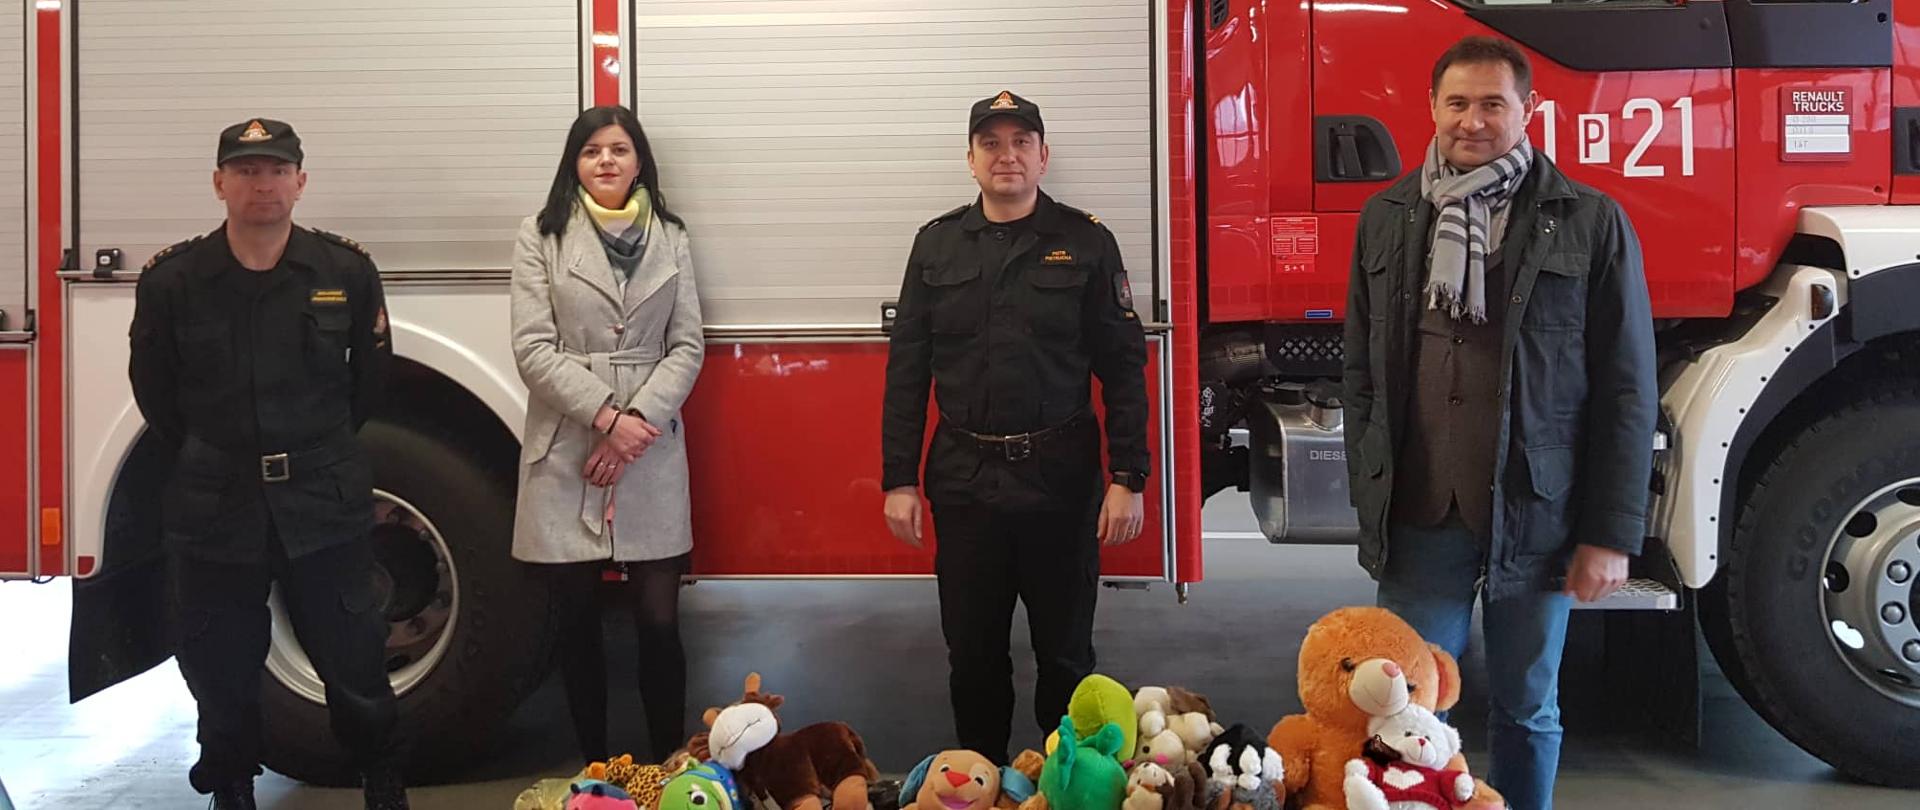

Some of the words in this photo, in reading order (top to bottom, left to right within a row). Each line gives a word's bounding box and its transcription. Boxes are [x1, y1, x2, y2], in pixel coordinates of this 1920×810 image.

[1792, 91, 1845, 102] RENAULT
[1793, 102, 1844, 112] TRUCKS
[1535, 100, 1556, 165] 1
[1583, 119, 1605, 159] P
[1622, 97, 1694, 177] 21
[1284, 264, 1291, 272] 5
